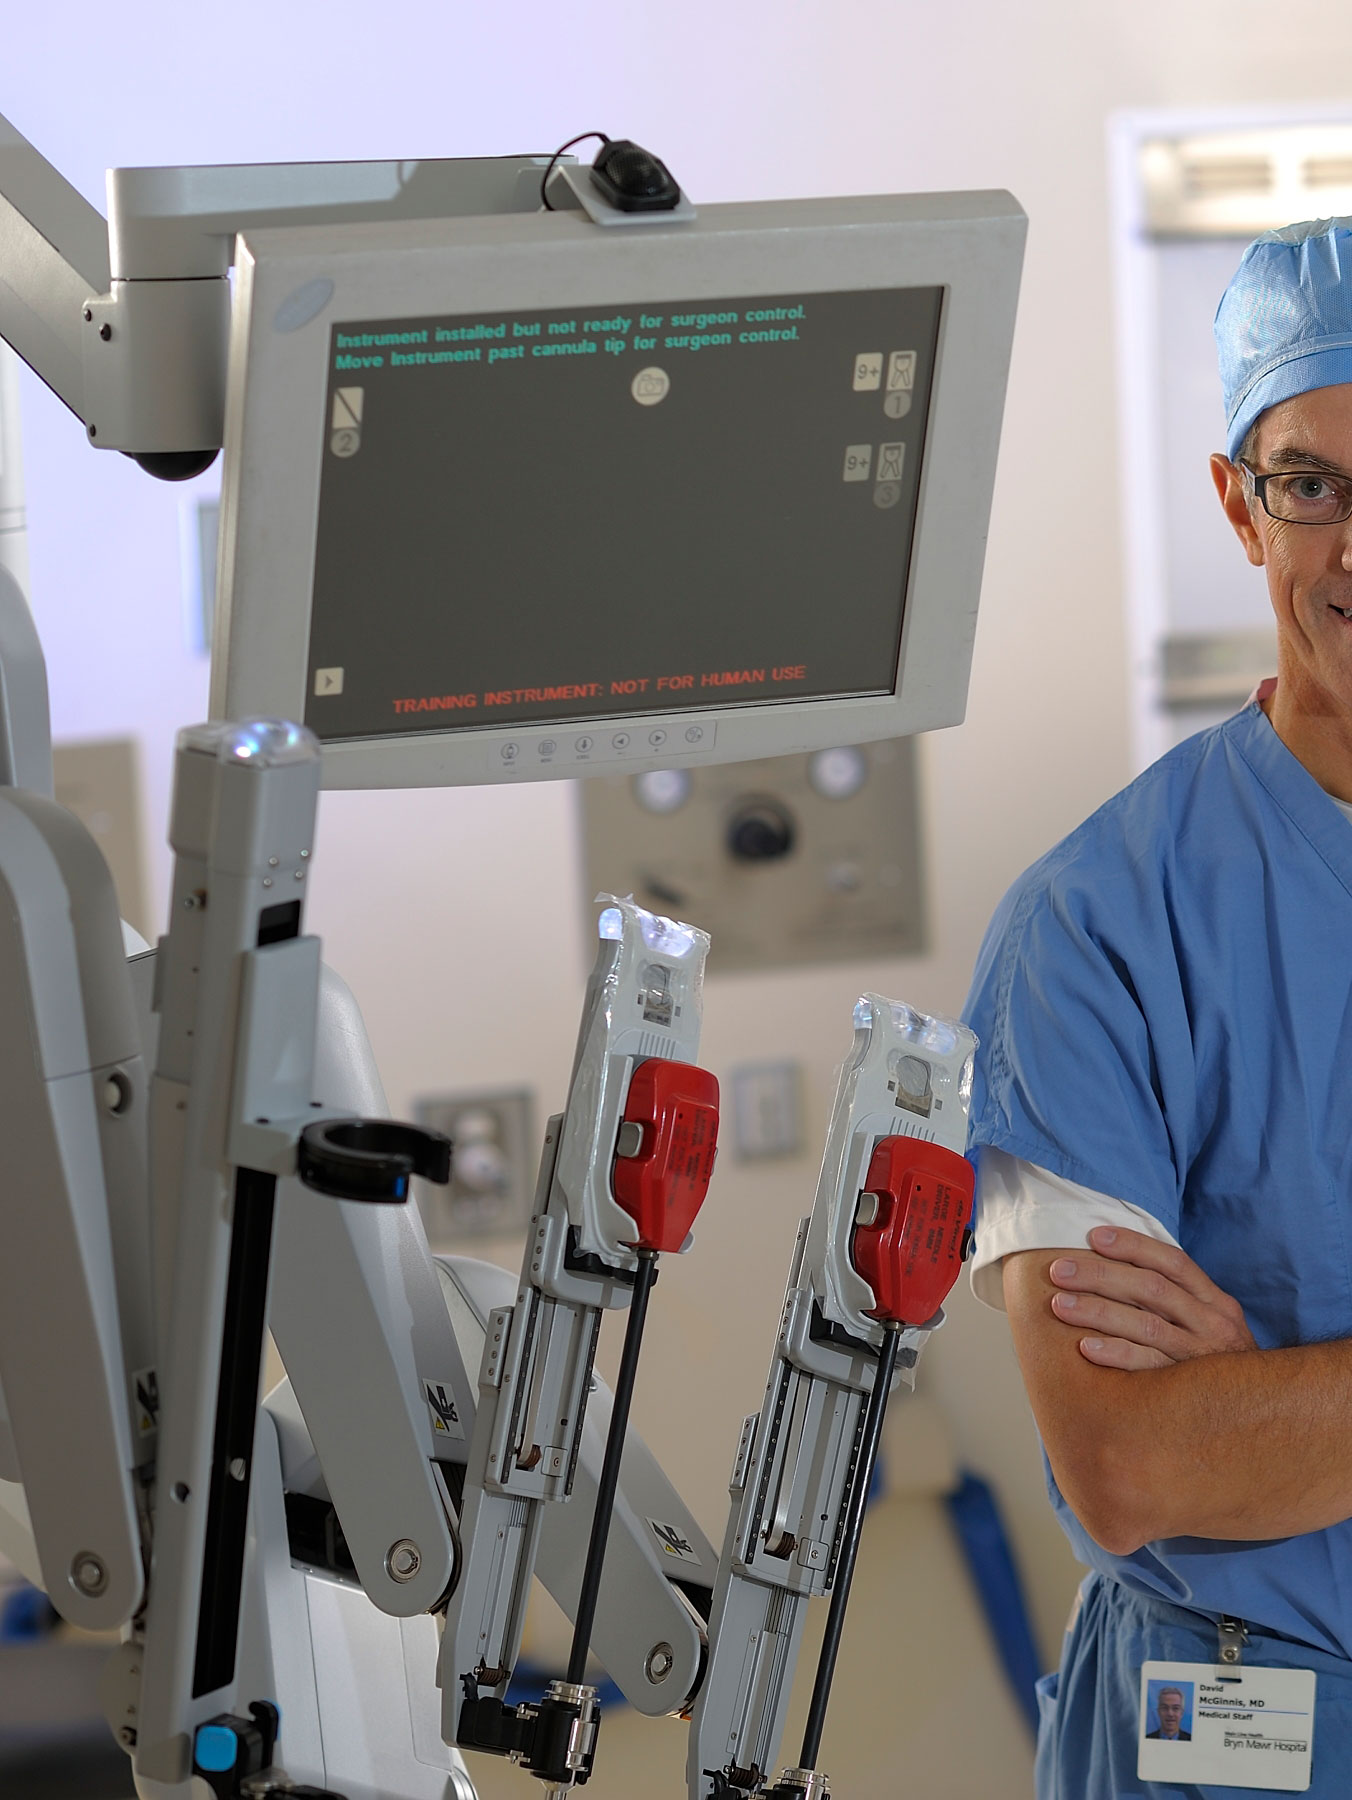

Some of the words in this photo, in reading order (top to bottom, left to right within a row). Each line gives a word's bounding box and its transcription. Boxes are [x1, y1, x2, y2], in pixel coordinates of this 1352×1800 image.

[336, 329, 428, 348] Instrument
[435, 323, 506, 342] installed
[513, 322, 541, 337] but
[548, 319, 577, 335] not
[583, 316, 632, 334] ready
[640, 314, 663, 329] for
[671, 310, 738, 330] surgeon
[745, 304, 806, 322] control.
[335, 353, 384, 370] Move
[487, 345, 525, 364] past
[532, 339, 597, 357] cannula
[605, 335, 626, 355] tip
[634, 334, 657, 351] for
[665, 330, 732, 351] surgeon
[739, 325, 800, 344] control.
[857, 364, 879, 380] 9+
[339, 432, 352, 451] 2
[847, 456, 869, 472] 9+
[393, 693, 477, 714] TRAINING
[484, 683, 603, 705] INSTRUMENT:
[610, 678, 650, 695] NOT
[657, 675, 694, 690] FOR
[701, 668, 765, 687] HUMAN
[771, 665, 807, 680] USE
[1200, 1684, 1224, 1693] David
[1199, 1696, 1246, 1708] McGinnis,
[1249, 1700, 1265, 1708] MD
[1199, 1711, 1231, 1720] Medical
[1232, 1713, 1253, 1721] Staff
[1224, 1738, 1243, 1750] Bryn
[1246, 1740, 1271, 1750] Mawr
[1274, 1742, 1307, 1753] Hospital
